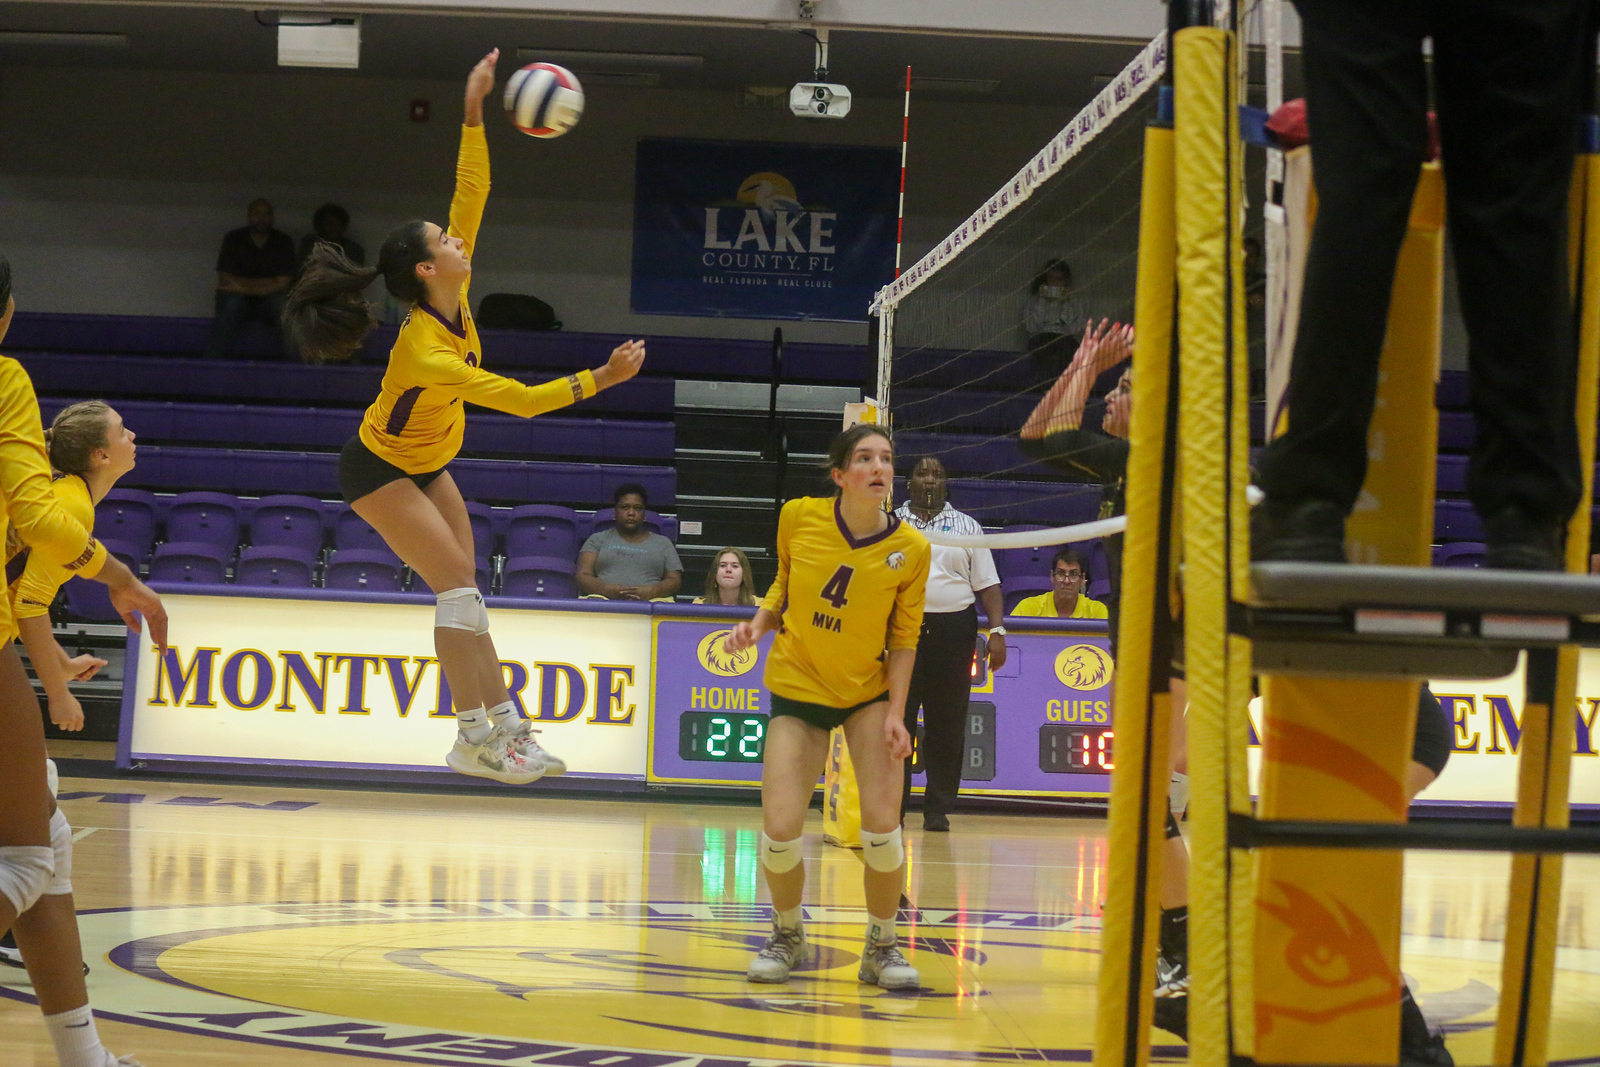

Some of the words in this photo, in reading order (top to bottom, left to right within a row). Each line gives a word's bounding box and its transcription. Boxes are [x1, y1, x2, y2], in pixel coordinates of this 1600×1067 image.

[703, 207, 837, 254] LAKE
[808, 256, 835, 272] FL
[702, 276, 725, 284] REAL
[729, 277, 768, 285] FLORIDA
[777, 279, 800, 287] REAL
[804, 280, 833, 289] CLOSE
[819, 563, 855, 610] 4
[812, 611, 841, 633] MVA
[148, 645, 636, 727] MONTVRDE
[691, 686, 760, 711] HOME
[1046, 699, 1111, 723] GUES
[706, 717, 763, 758] 22
